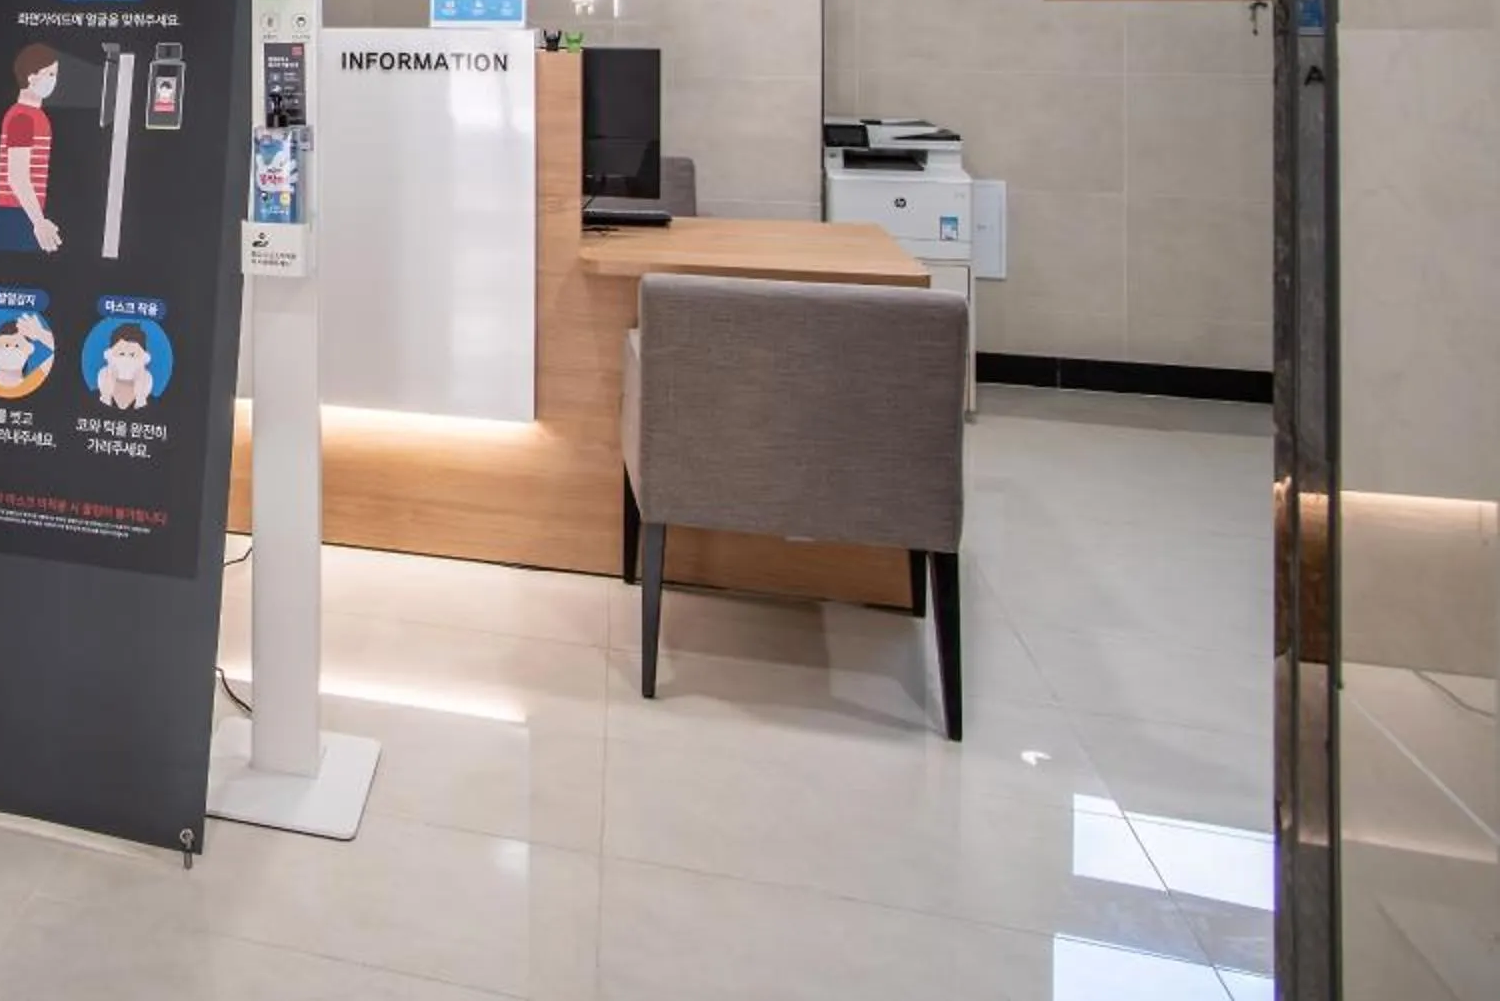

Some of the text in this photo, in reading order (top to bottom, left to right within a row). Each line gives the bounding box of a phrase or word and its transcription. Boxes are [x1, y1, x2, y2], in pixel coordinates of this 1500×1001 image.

[85, 12, 119, 27] 얼굴을
[341, 52, 508, 72] INFORMATION
[105, 301, 159, 317] 마스크 착용
[76, 417, 167, 441] 코와 턱을 완전히
